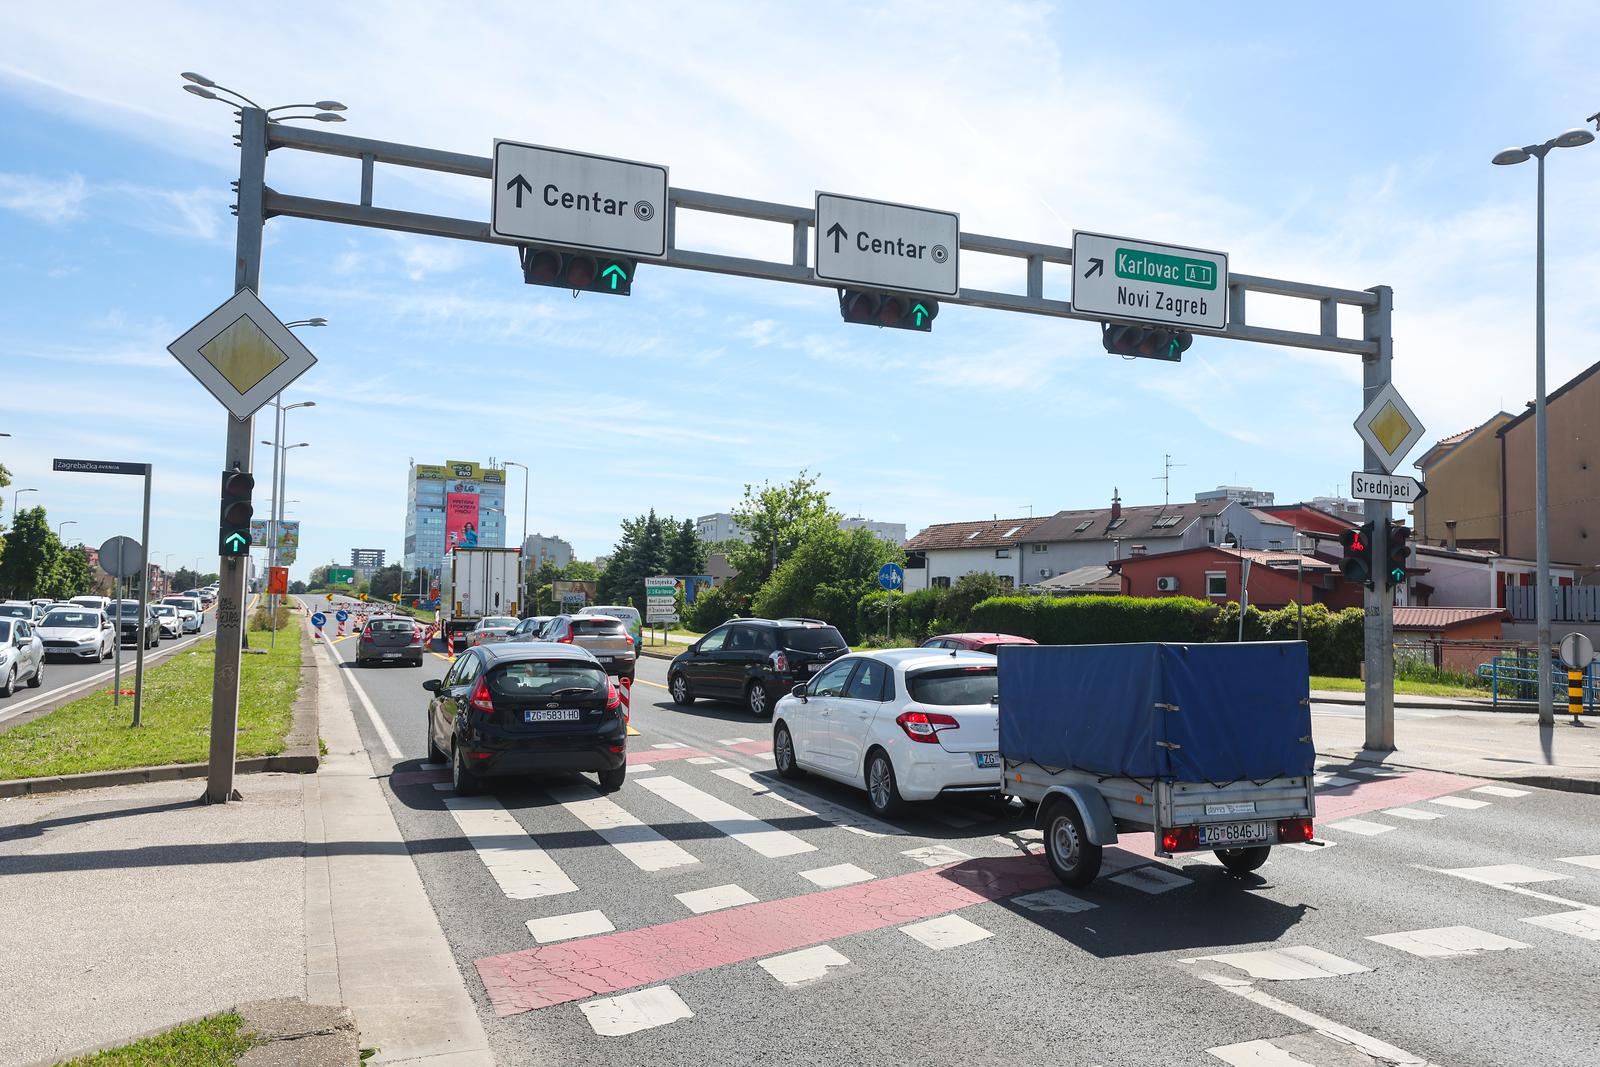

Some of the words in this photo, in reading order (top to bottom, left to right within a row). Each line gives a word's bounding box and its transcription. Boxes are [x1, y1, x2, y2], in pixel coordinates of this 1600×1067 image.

[543, 183, 628, 218] Centar
[857, 231, 927, 261] Centar
[1119, 254, 1179, 280] Karlovac
[1118, 286, 1149, 308] Novi
[1156, 291, 1208, 318] Zagreb
[57, 460, 98, 470] Zagrebačka
[464, 484, 474, 492] LG
[1356, 477, 1411, 498] Srednjaci
[531, 711, 542, 721] ZG
[984, 753, 995, 764] ZG
[1207, 827, 1220, 841] ZG
